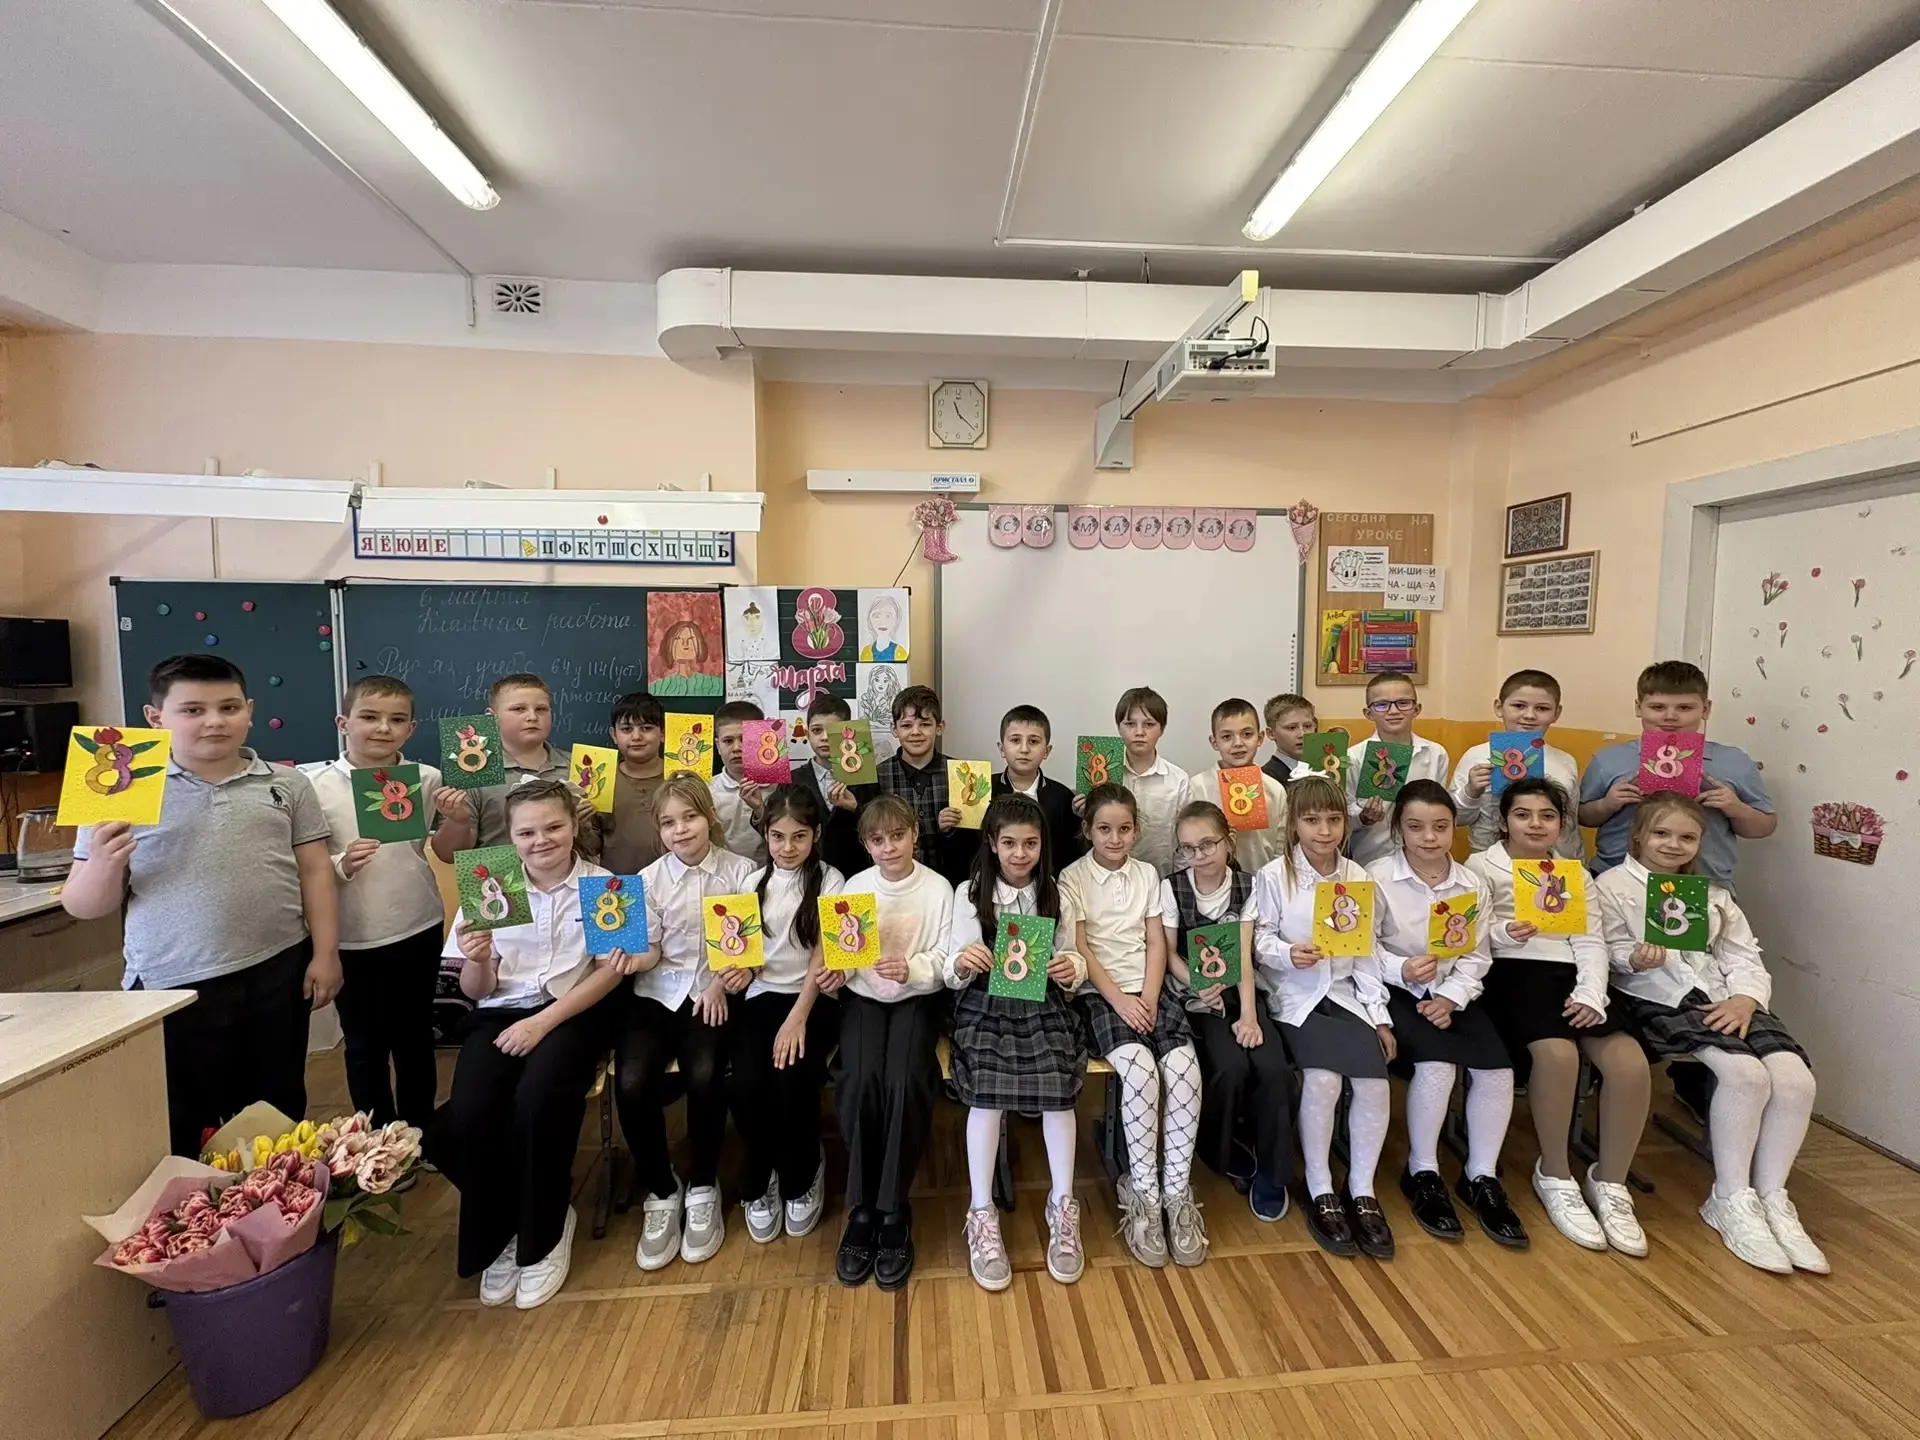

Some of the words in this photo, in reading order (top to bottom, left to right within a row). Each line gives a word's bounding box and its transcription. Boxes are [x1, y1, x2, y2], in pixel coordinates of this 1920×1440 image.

[937, 398, 945, 407] 10
[955, 387, 962, 396] 12
[974, 399, 980, 408] 2
[1326, 512, 1387, 523] СЕГОДНЯ
[1411, 514, 1429, 526] НА
[1355, 529, 1404, 541] УРОКЕ
[361, 537, 374, 551] Я
[380, 535, 392, 552] Ё
[396, 537, 411, 552] Ю
[416, 537, 429, 552] И
[434, 538, 447, 553] Е
[541, 540, 554, 555] П
[559, 541, 572, 555] Ф
[576, 541, 590, 556] К
[594, 541, 607, 556] Т
[611, 541, 626, 556] Ш
[630, 542, 643, 557] С
[647, 543, 660, 557] Х
[665, 543, 678, 560] Ц
[683, 543, 695, 558] Ч
[699, 544, 714, 561] Щ
[717, 544, 730, 558] Ь
[1387, 580, 1400, 589] ЧА
[1407, 581, 1422, 591] ЩА
[1387, 593, 1400, 601] ЧУ
[1406, 594, 1421, 604] ЩУ
[792, 587, 844, 659] 8
[551, 658, 571, 676] 64
[457, 734, 488, 773] 8
[677, 732, 700, 766] 8
[758, 731, 779, 766] 8
[840, 739, 863, 773] 8
[1502, 747, 1527, 780] 8
[1654, 745, 1683, 779] 8
[1088, 753, 1109, 786] 8
[380, 780, 413, 821] 8
[1229, 782, 1253, 816] 8
[480, 877, 511, 921] 8
[595, 892, 625, 931] 8
[1332, 894, 1358, 933] 8
[719, 915, 748, 956] 8
[838, 914, 865, 953] 8
[1443, 914, 1470, 948] 8
[1003, 938, 1028, 982] 8
[1201, 945, 1228, 978] 8
